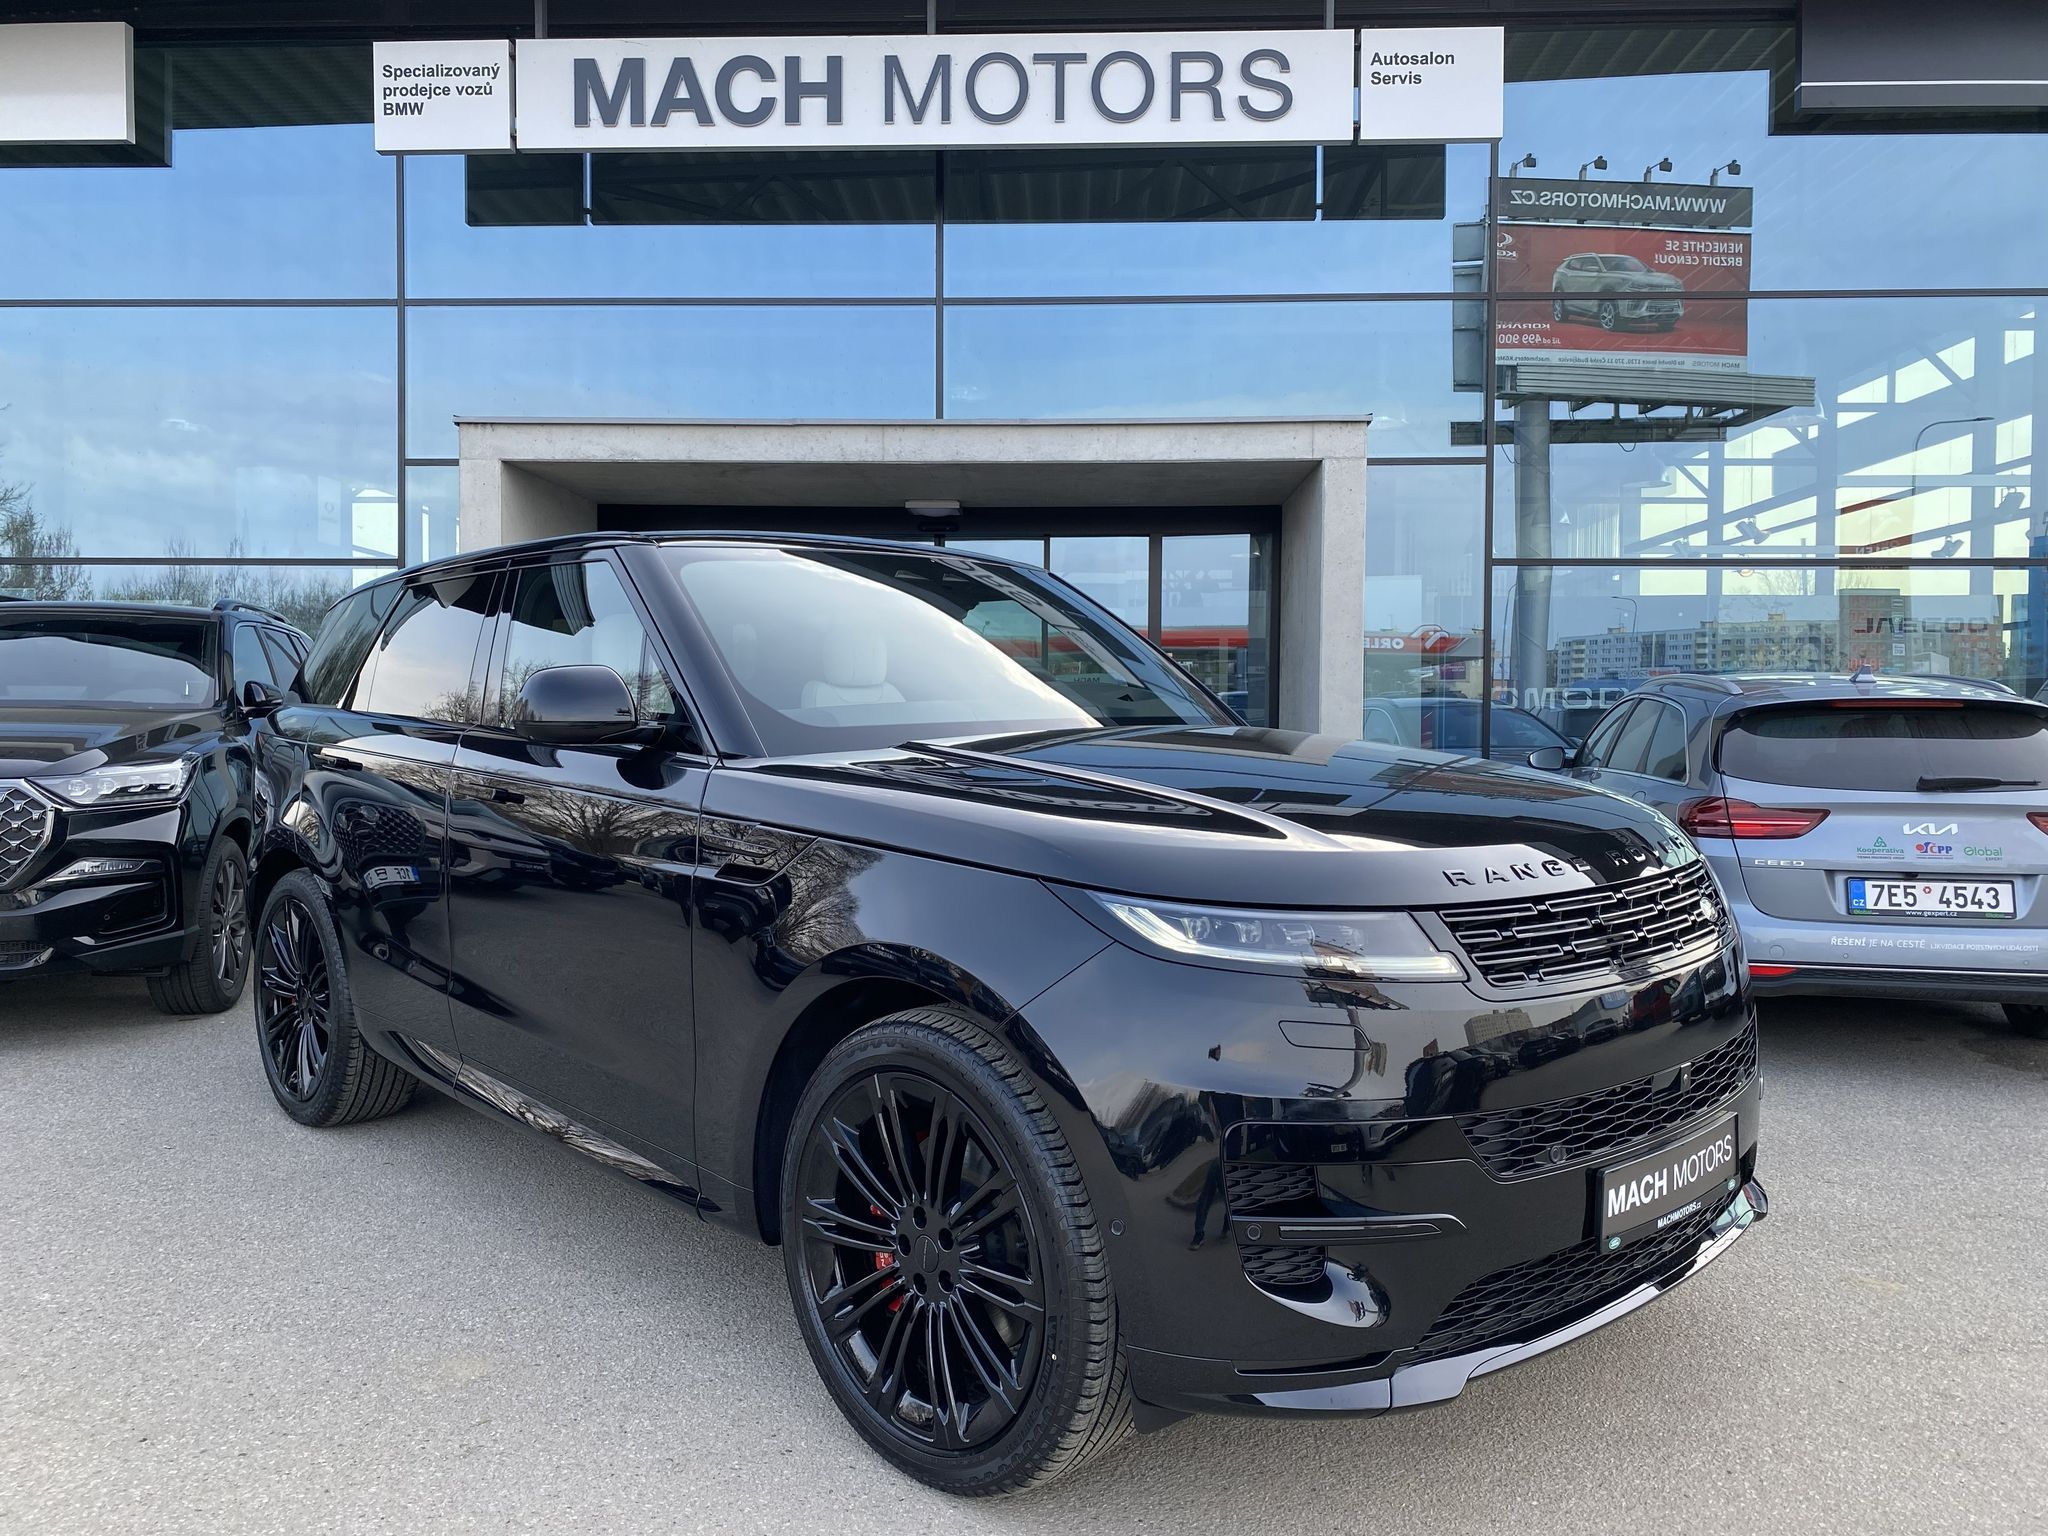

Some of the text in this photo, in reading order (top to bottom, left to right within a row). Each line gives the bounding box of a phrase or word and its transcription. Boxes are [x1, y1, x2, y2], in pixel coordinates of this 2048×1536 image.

[1370, 51, 1456, 67] Autosalon
[382, 62, 500, 84] Specializovaný
[1370, 70, 1423, 86] Servis
[382, 79, 494, 101] prodejce vozů
[573, 49, 1294, 128] MACH MOTORS
[383, 102, 425, 117] BMW
[1856, 846, 1905, 856] Kooperativa
[1963, 845, 2003, 858] Global
[1442, 837, 1687, 888] RANGE ROVER
[1852, 898, 1866, 907] CZ
[1871, 884, 2000, 910] 7E5 4543
[1905, 910, 1958, 918] www.gexpert.cz
[1830, 935, 1867, 947] ŘEŠENÍ
[1868, 938, 1878, 948] JE
[1880, 939, 1894, 948] NA
[1607, 1134, 1732, 1218] MACH MOTORS
